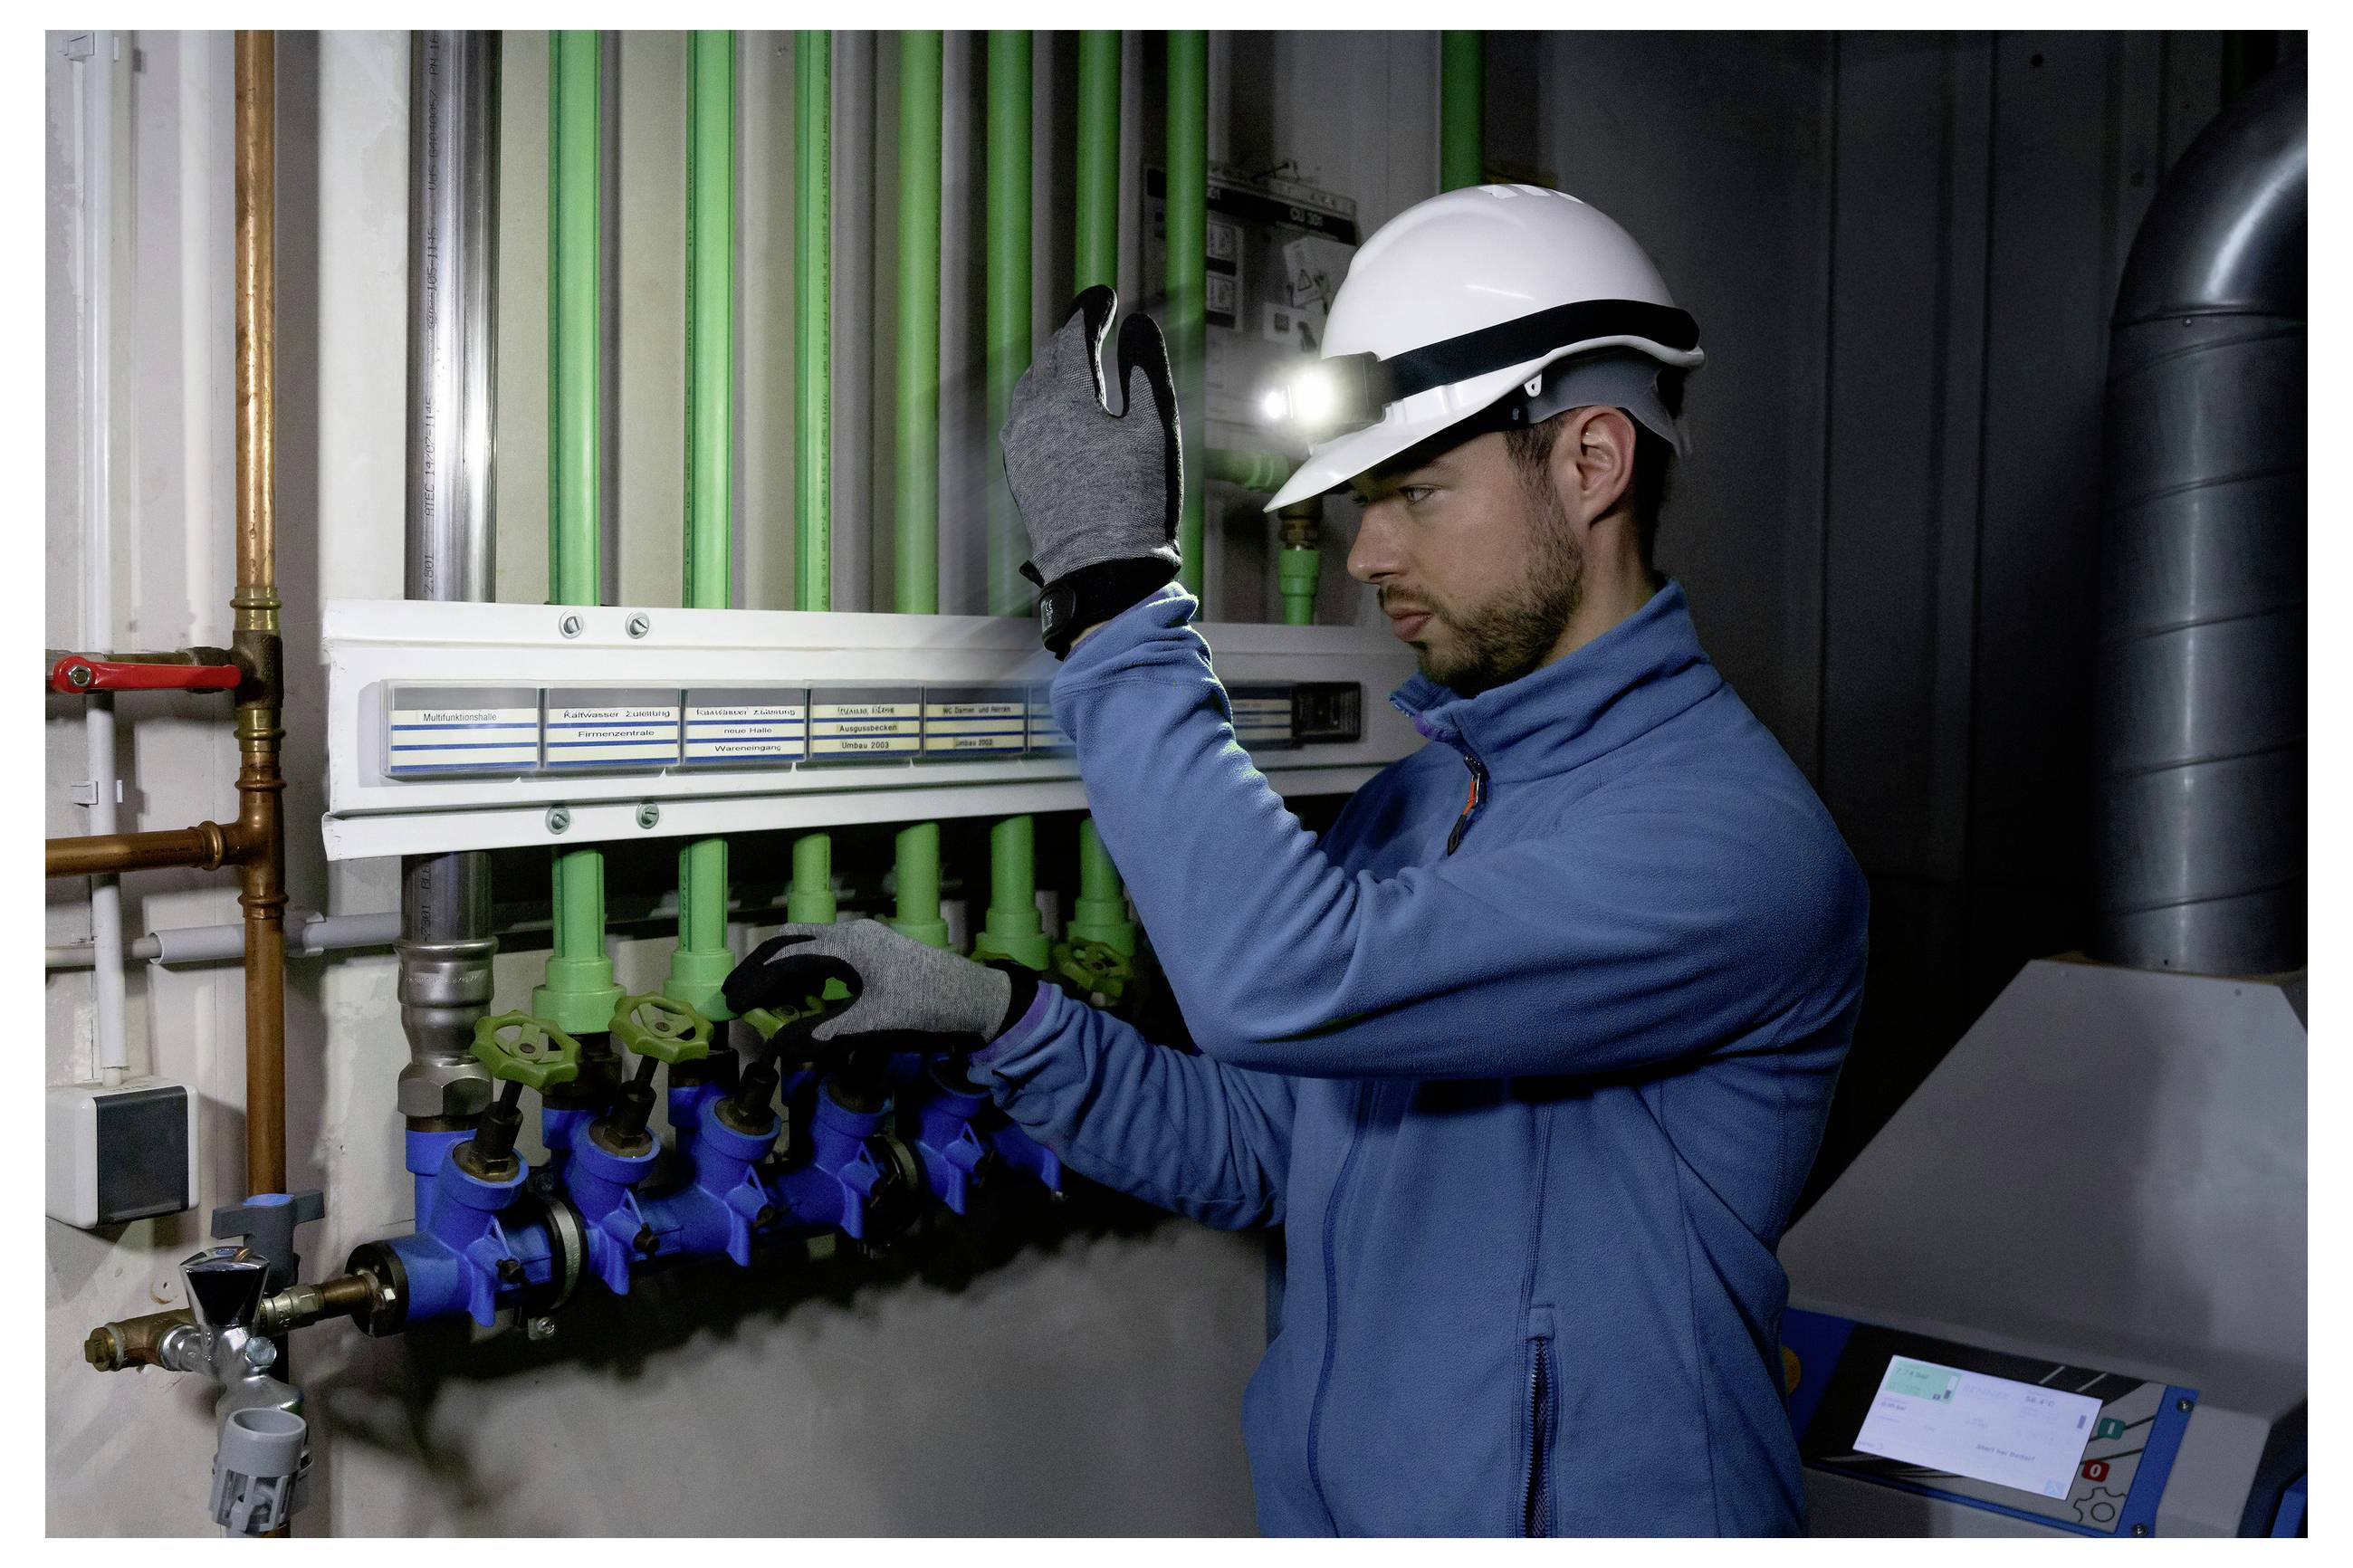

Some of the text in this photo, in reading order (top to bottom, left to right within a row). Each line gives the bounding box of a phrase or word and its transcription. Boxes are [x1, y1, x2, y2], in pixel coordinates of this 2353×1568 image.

[423, 712, 497, 722] Multifunktionshalle
[839, 724, 897, 733] Ausgussbecken
[578, 730, 655, 738] Firmenzentrale
[714, 744, 781, 752] Wareneingang
[841, 741, 890, 750] Umbau 2003
